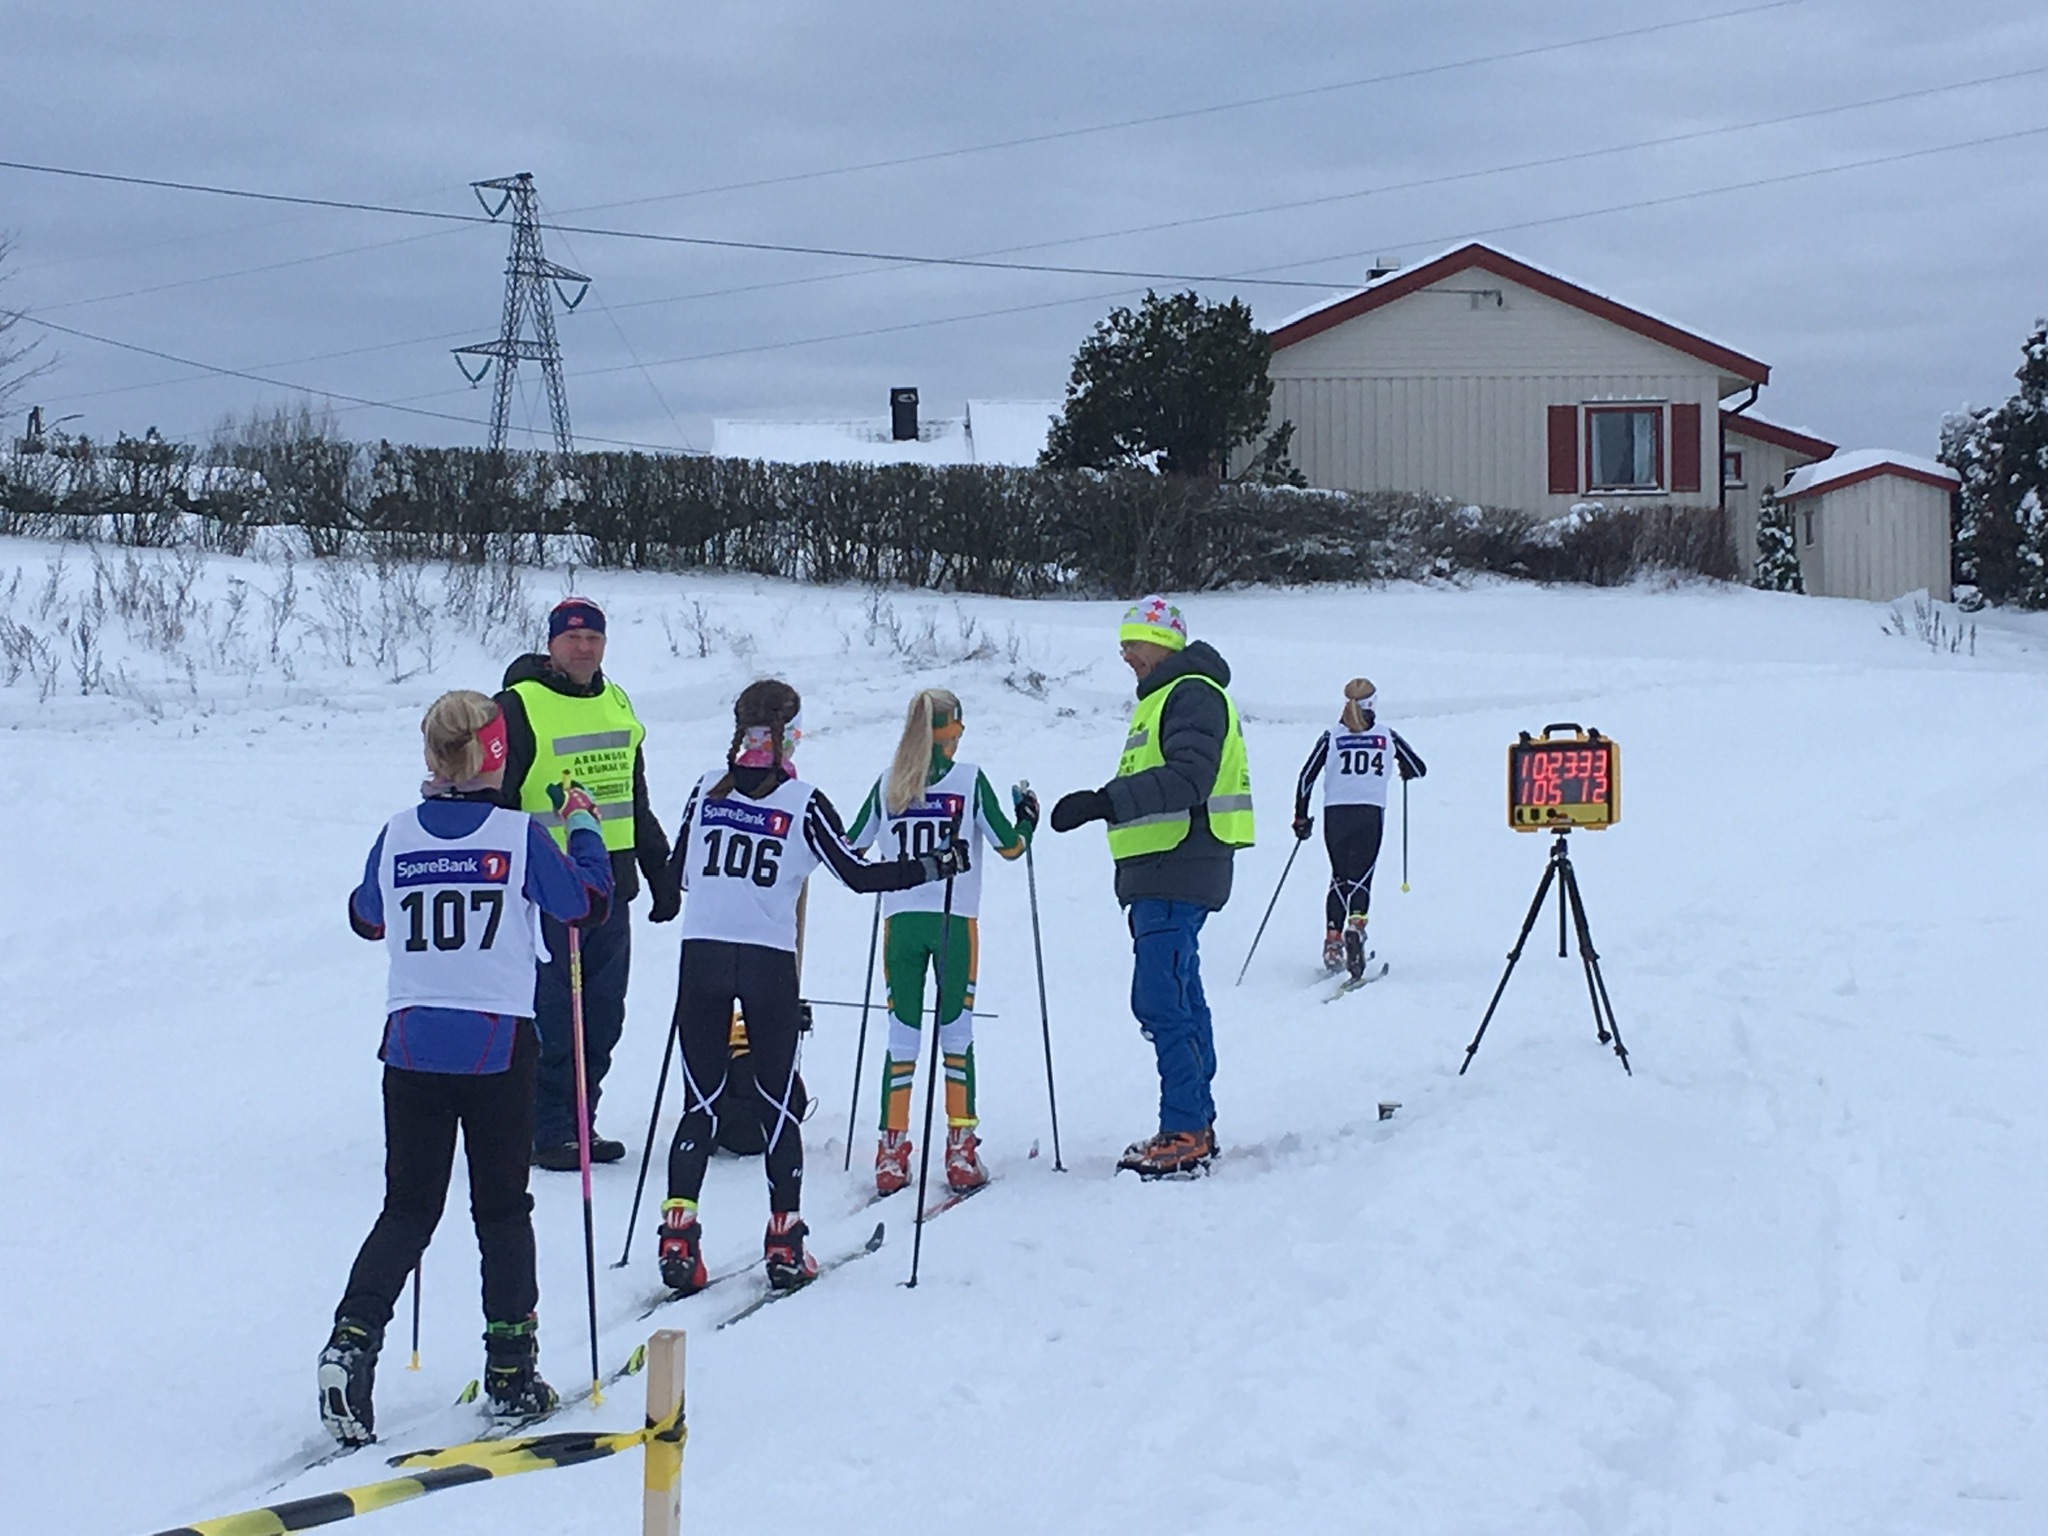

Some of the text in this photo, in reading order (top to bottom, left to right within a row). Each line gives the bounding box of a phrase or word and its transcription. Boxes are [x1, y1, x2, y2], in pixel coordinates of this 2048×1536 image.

[1339, 750, 1385, 777] 104
[1521, 777, 1608, 805] 105 12
[703, 804, 783, 831] SpareBank 1
[948, 799, 957, 813] 1
[397, 857, 499, 878] SpareBank 1
[702, 829, 784, 888] 106
[400, 890, 504, 952] 107
